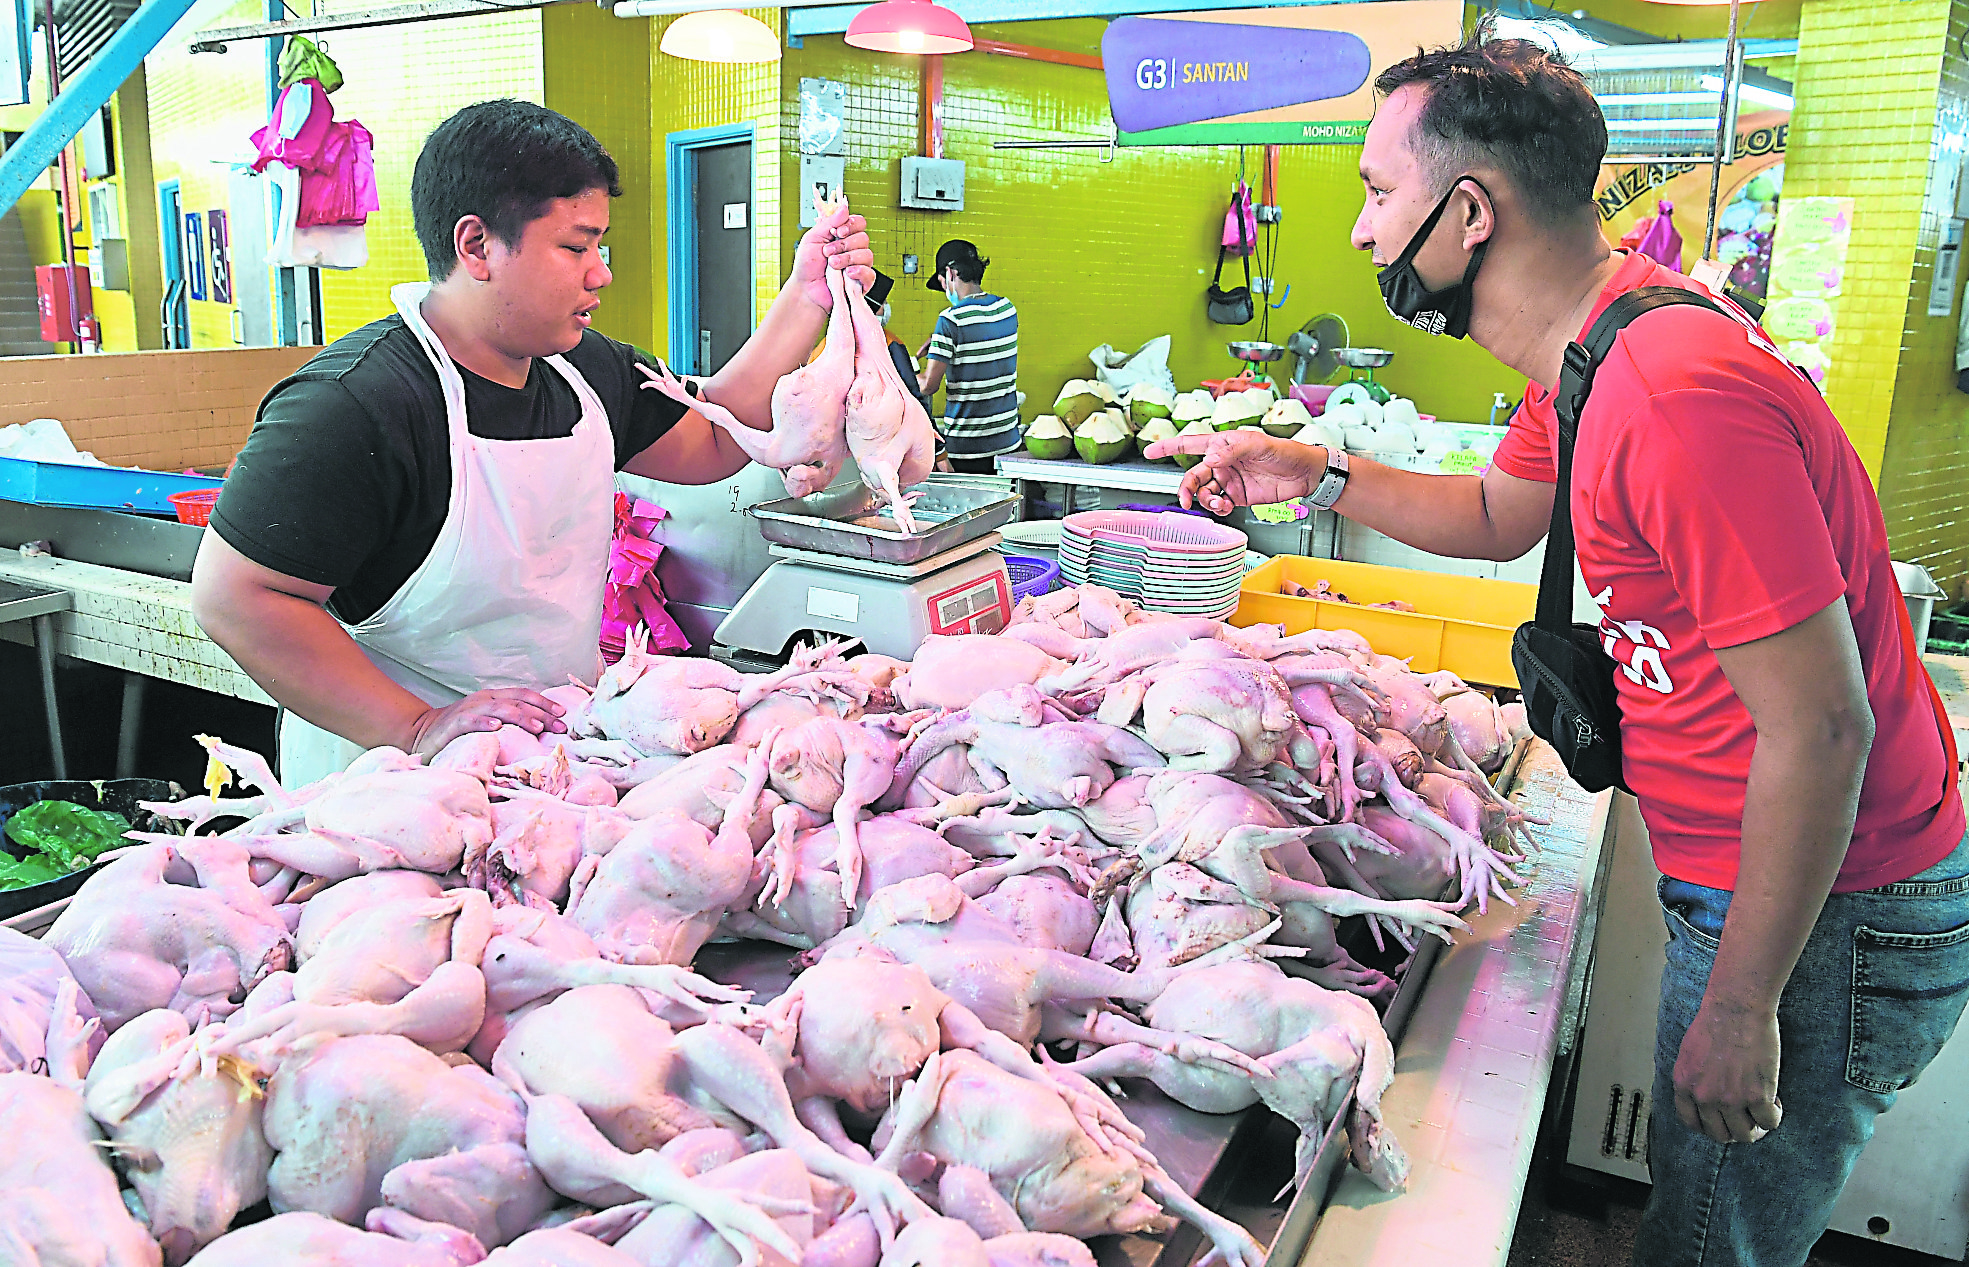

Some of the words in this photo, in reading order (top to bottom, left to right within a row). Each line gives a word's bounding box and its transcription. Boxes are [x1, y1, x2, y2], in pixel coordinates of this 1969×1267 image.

[1135, 58, 1167, 90] G3
[1182, 61, 1249, 84] SANTAN
[1302, 125, 1334, 137] MOHD
